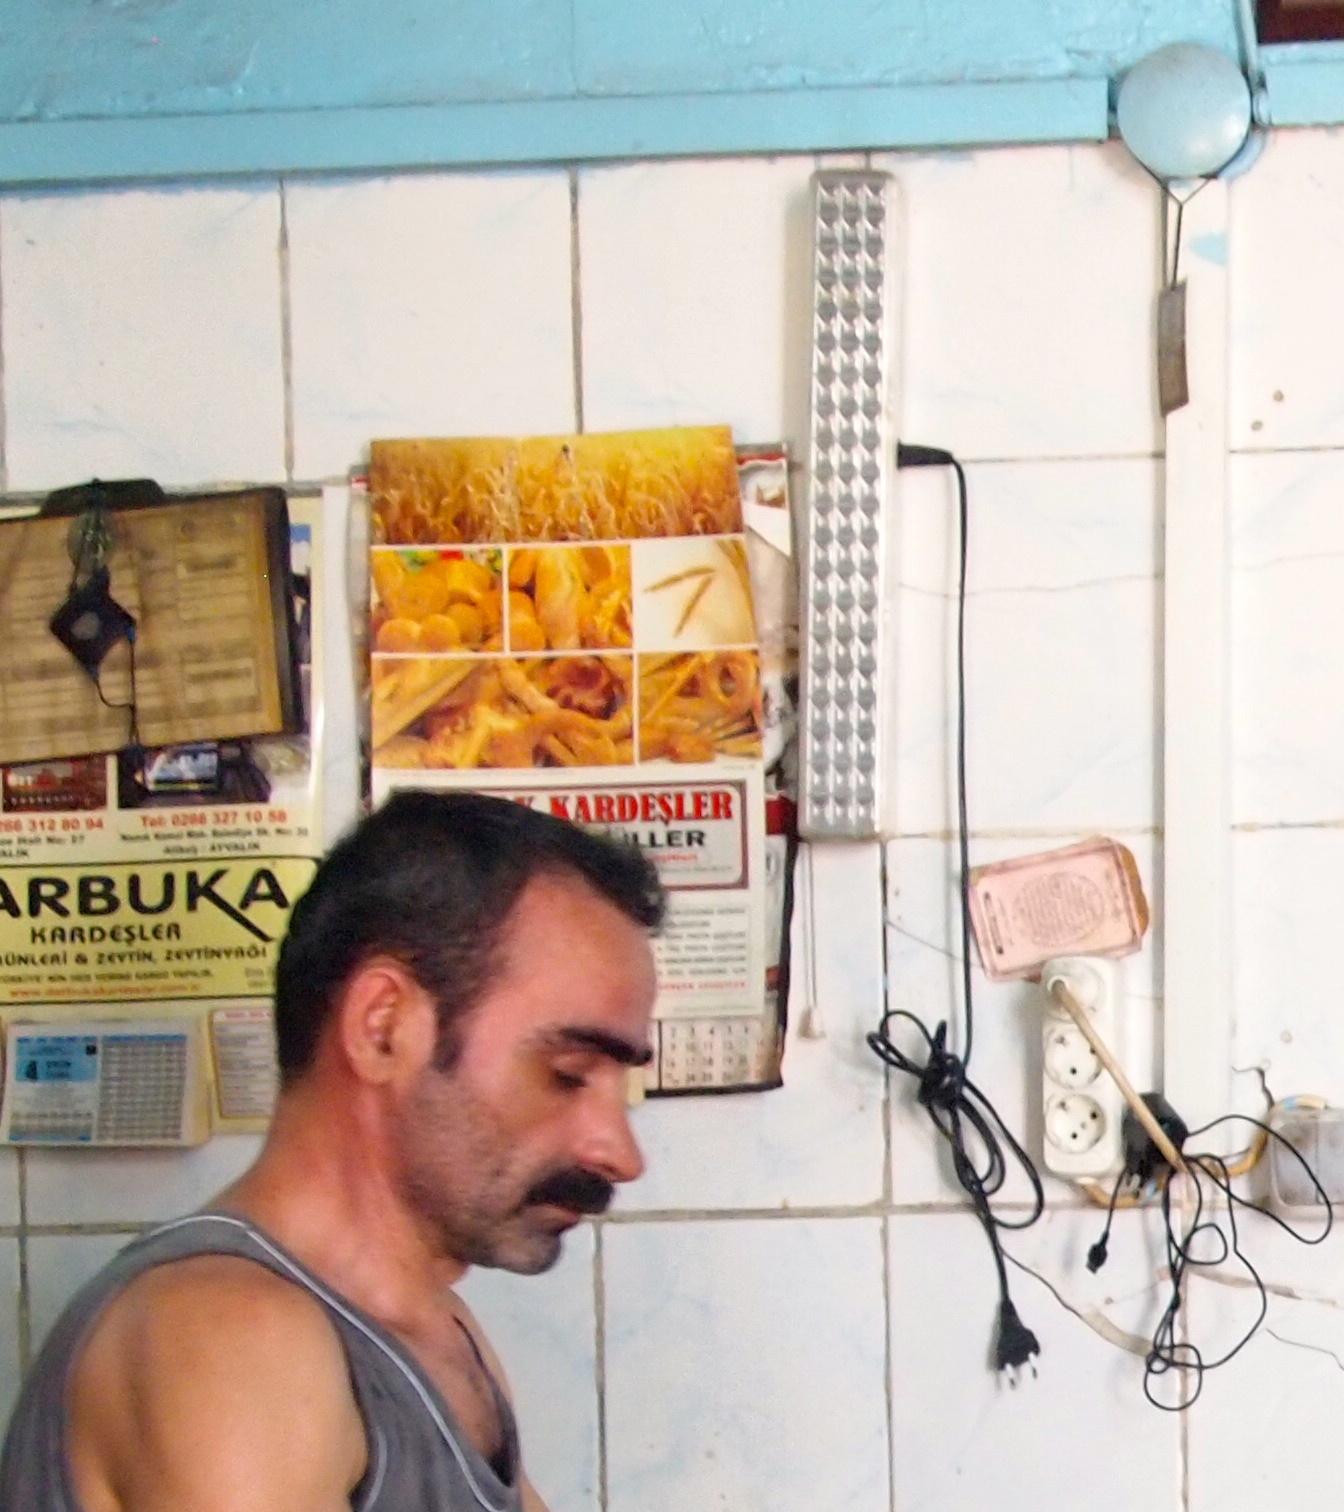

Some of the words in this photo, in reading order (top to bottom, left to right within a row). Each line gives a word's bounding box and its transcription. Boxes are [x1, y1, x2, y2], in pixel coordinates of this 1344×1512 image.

[551, 789, 733, 826] KARDEŞLER
[31, 923, 181, 946] KARDEŞLER
[0, 951, 67, 966] ÜNLERİ
